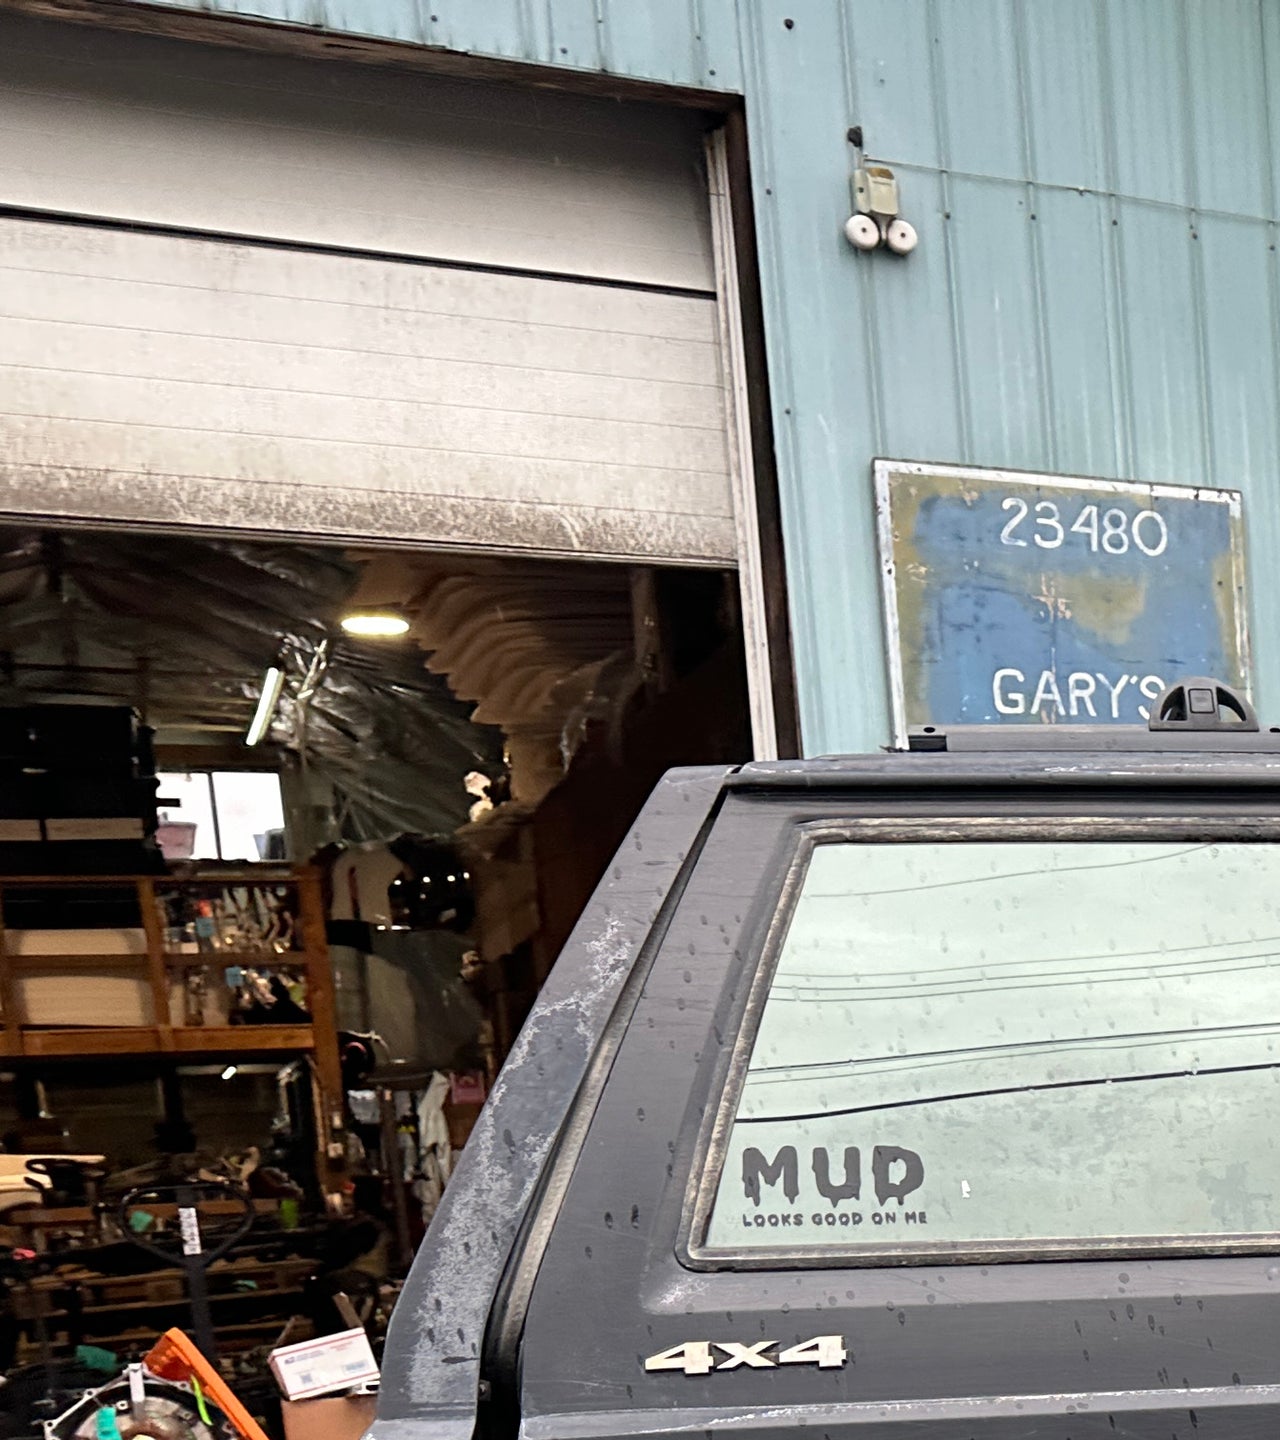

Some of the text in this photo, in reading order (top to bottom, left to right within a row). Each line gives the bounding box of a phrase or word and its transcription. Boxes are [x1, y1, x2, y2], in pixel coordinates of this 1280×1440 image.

[1000, 497, 1168, 556] 23480
[992, 668, 1166, 721] GARY'S
[742, 1145, 925, 1208] MUD
[742, 1211, 928, 1227] LOOKS GOOD ON ME
